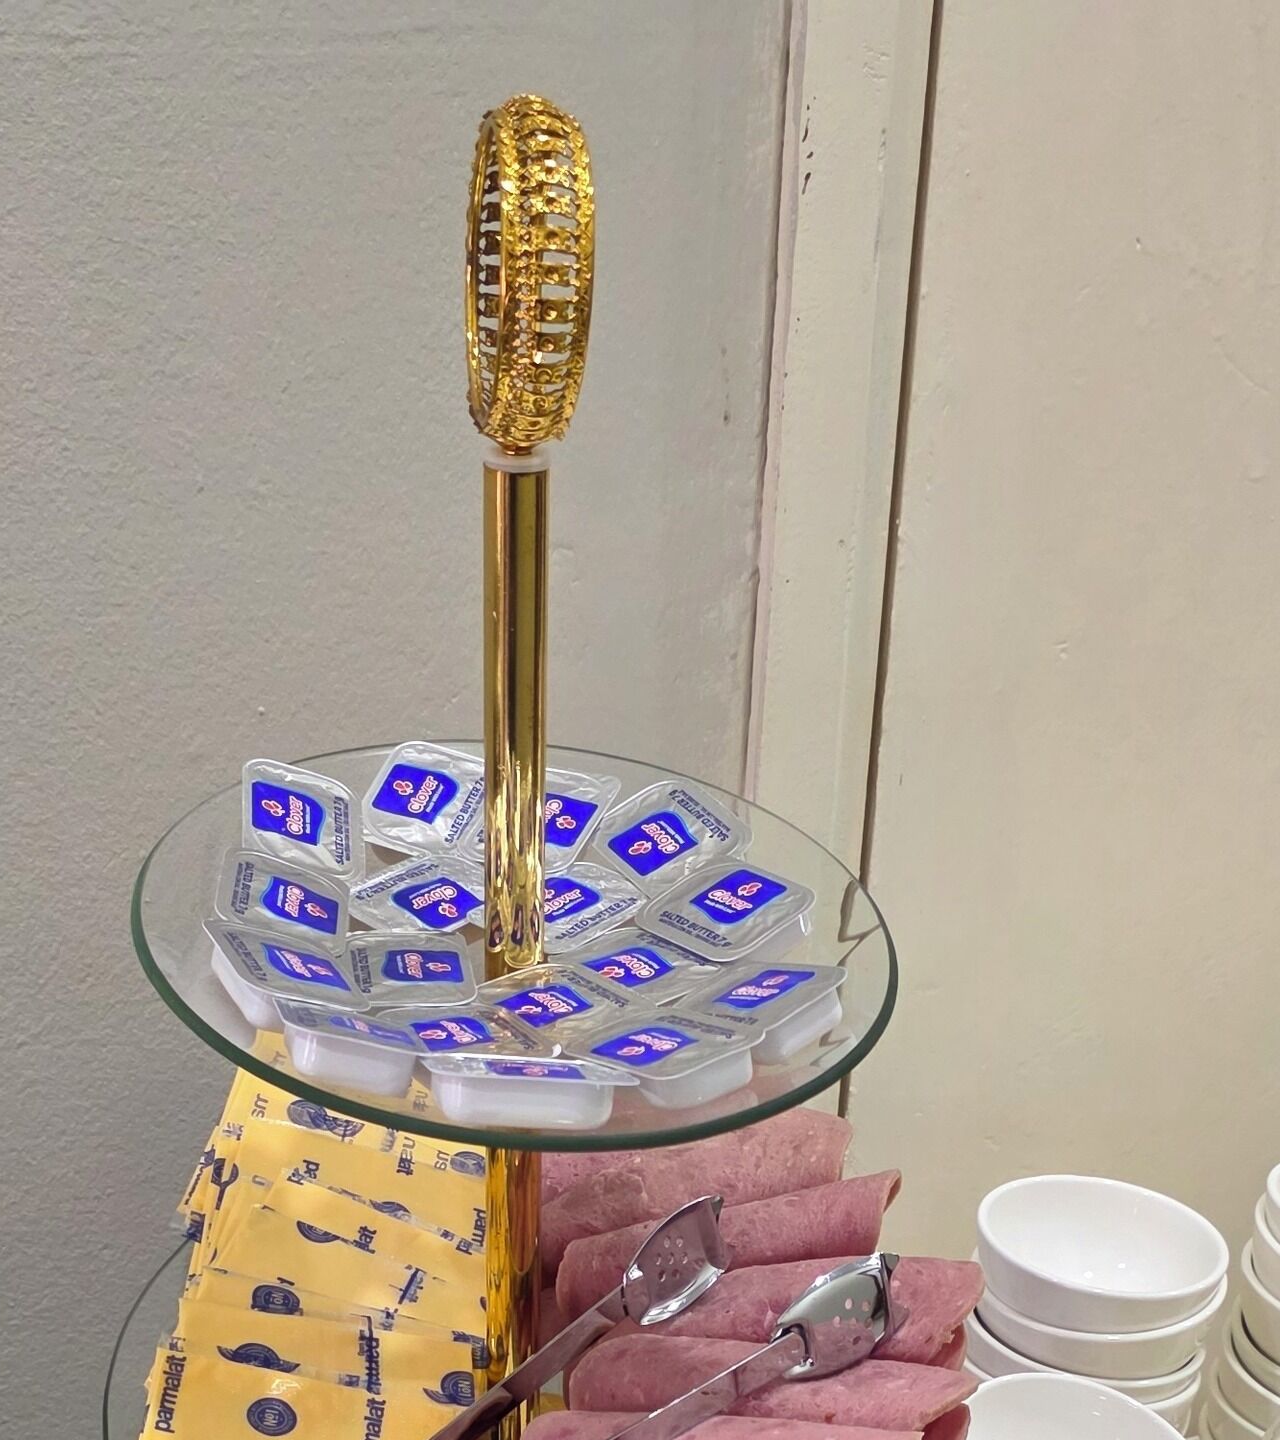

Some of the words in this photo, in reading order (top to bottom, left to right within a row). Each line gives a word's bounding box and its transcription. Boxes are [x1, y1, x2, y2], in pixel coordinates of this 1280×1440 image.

[408, 775, 438, 813] Clover
[286, 795, 303, 835] Clover
[444, 814, 464, 844] SALTED
[460, 787, 480, 814] BUTTER
[677, 799, 703, 820] BUTTER
[641, 823, 679, 854] Clover
[701, 816, 729, 842] SALTED
[334, 836, 344, 865] SALTED
[284, 885, 305, 917] Clover
[412, 886, 457, 910] Clover
[708, 889, 753, 911] Clover
[660, 910, 689, 928] SALTED
[687, 919, 721, 941] BUTTER
[404, 952, 423, 978] Clover
[611, 955, 655, 978] Clover
[528, 991, 573, 1013] Clover
[155, 1354, 187, 1433] parmalat
